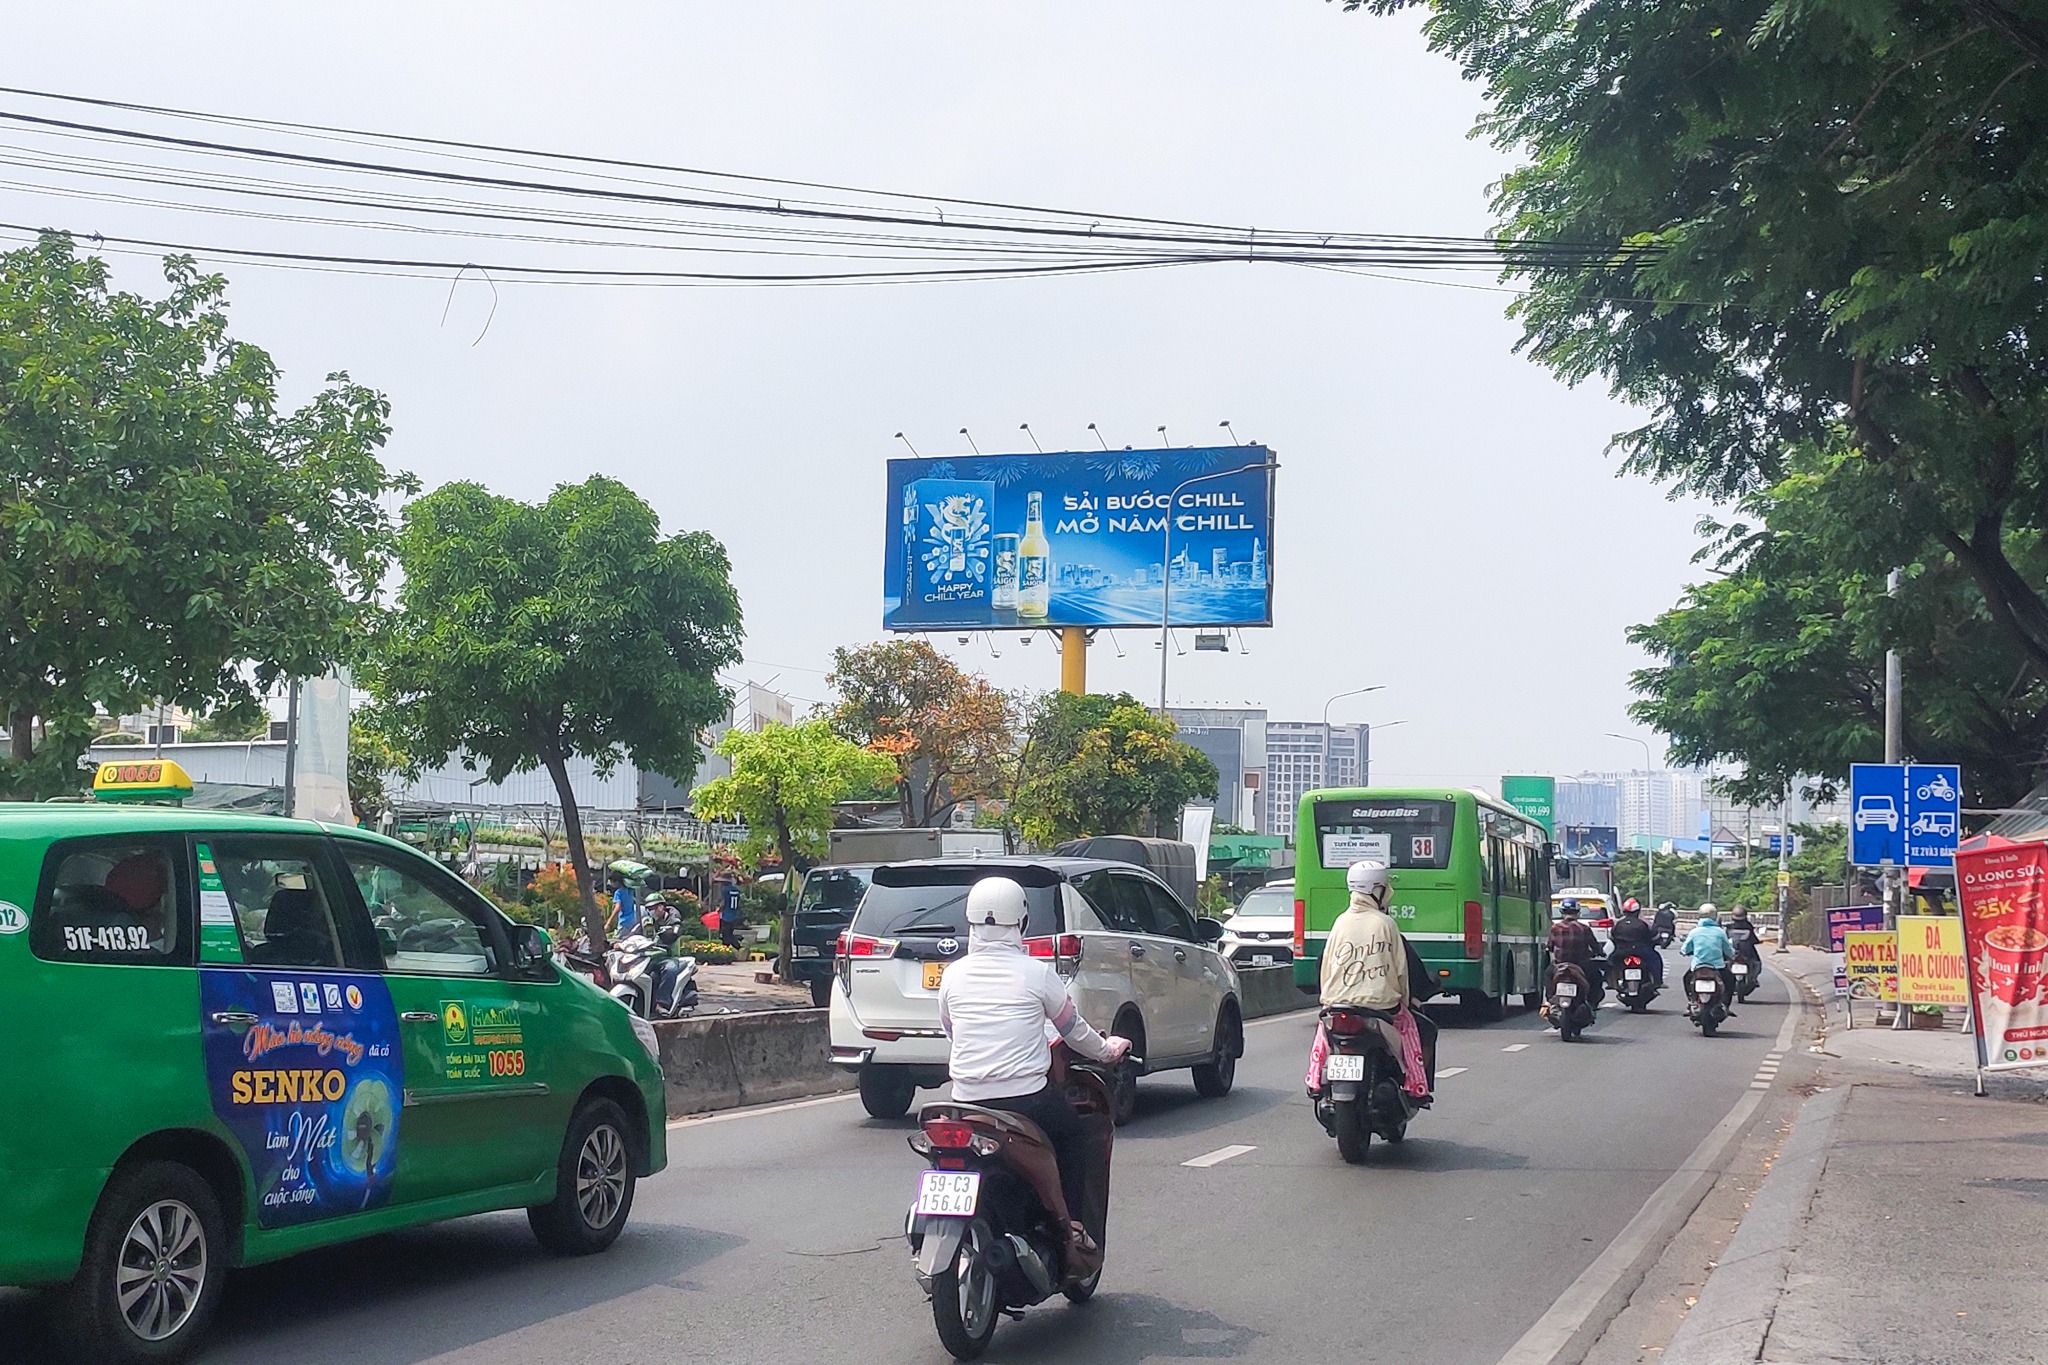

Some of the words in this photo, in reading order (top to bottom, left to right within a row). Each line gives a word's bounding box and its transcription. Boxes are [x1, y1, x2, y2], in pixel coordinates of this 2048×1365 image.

[1064, 491, 1098, 511] SẢI
[1106, 490, 1170, 510] BƯỚC
[1178, 493, 1245, 508] CHILL
[1055, 511, 1100, 534] MỞ
[1108, 514, 1168, 533] NĂM
[1177, 514, 1255, 531] CHILL
[937, 582, 974, 593] HAPPY
[992, 576, 1017, 585] SAIGO
[924, 592, 956, 602] CHILL
[957, 590, 985, 600] YEAR
[117, 764, 161, 782] 1055
[1352, 807, 1420, 819] SaigonBus
[1413, 839, 1432, 856] 38
[1911, 846, 1919, 857] XE
[1964, 872, 1975, 884] Ô
[1978, 869, 2015, 883] LONG
[2017, 864, 2044, 878] SỮA
[0, 908, 19, 927] 12
[1387, 904, 1416, 920] 5.82
[1976, 899, 2015, 919] 25K
[63, 926, 151, 951] 51F-413.92
[1925, 919, 1941, 949] ĐÁ
[1849, 940, 1875, 962] CƠM
[1901, 953, 1924, 978] HOA
[369, 1043, 380, 1057] đã
[380, 1043, 390, 1057] có
[488, 1049, 525, 1077] 1055
[232, 1069, 346, 1104] SENKO
[266, 1131, 290, 1150] Làm
[287, 1111, 336, 1162] Mát
[281, 1164, 300, 1181] cho
[929, 1175, 971, 1192] 59-C3
[264, 1186, 291, 1208] cuộc
[290, 1182, 317, 1204] sống
[922, 1193, 973, 1212] 156.40
